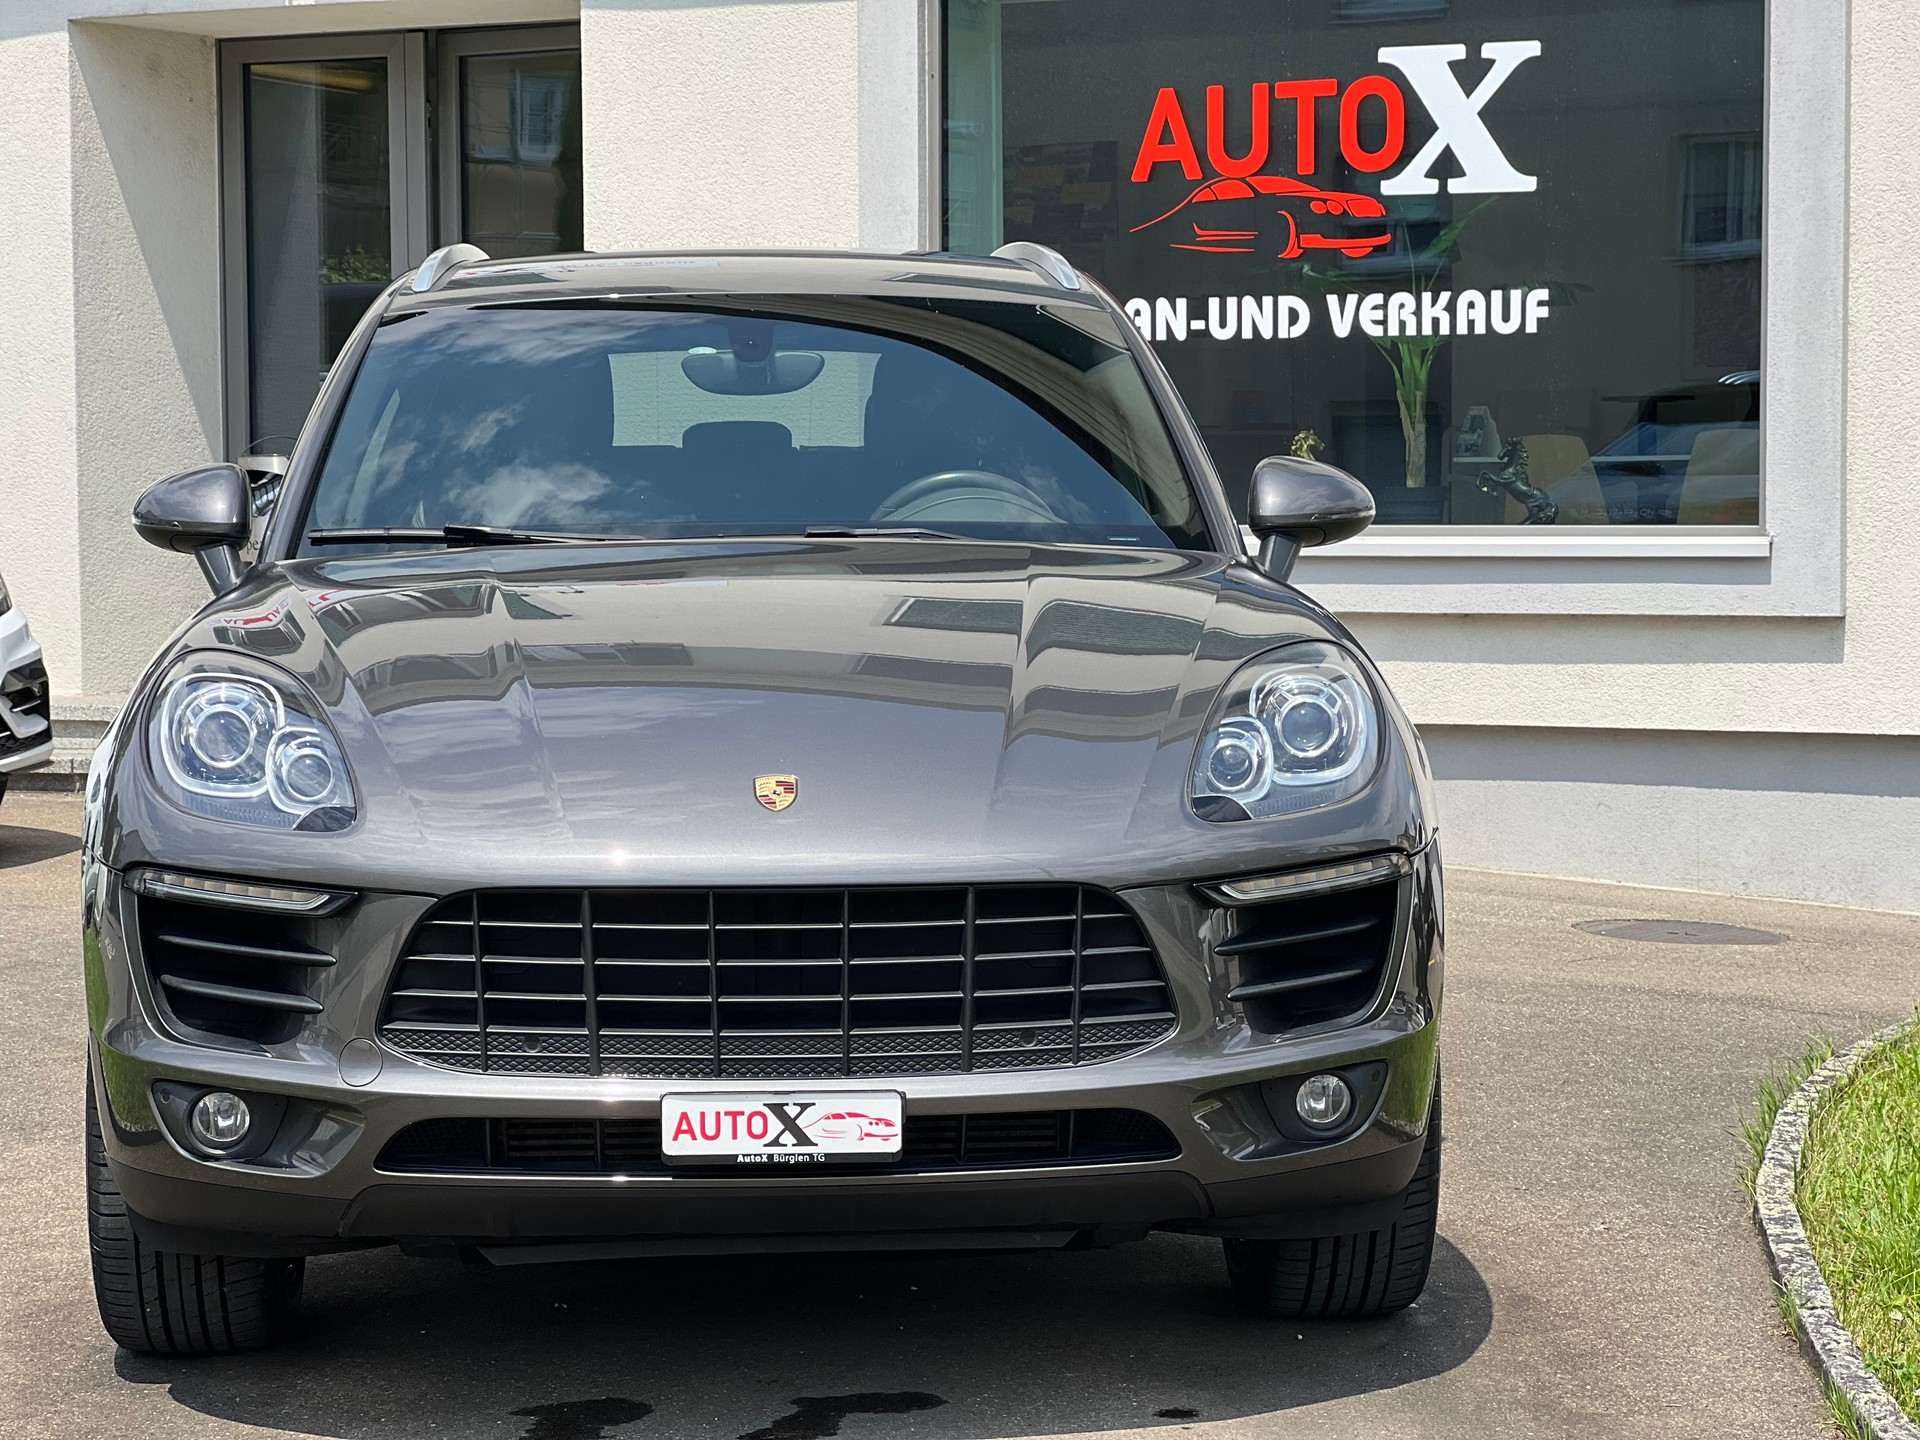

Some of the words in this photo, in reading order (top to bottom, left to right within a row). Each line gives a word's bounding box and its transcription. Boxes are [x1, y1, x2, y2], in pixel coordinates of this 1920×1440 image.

[1325, 289, 1550, 338] VERKAUF
[736, 1154, 768, 1163] AutoX
[773, 1153, 810, 1164] Bürglen
[812, 1153, 826, 1162] TG
